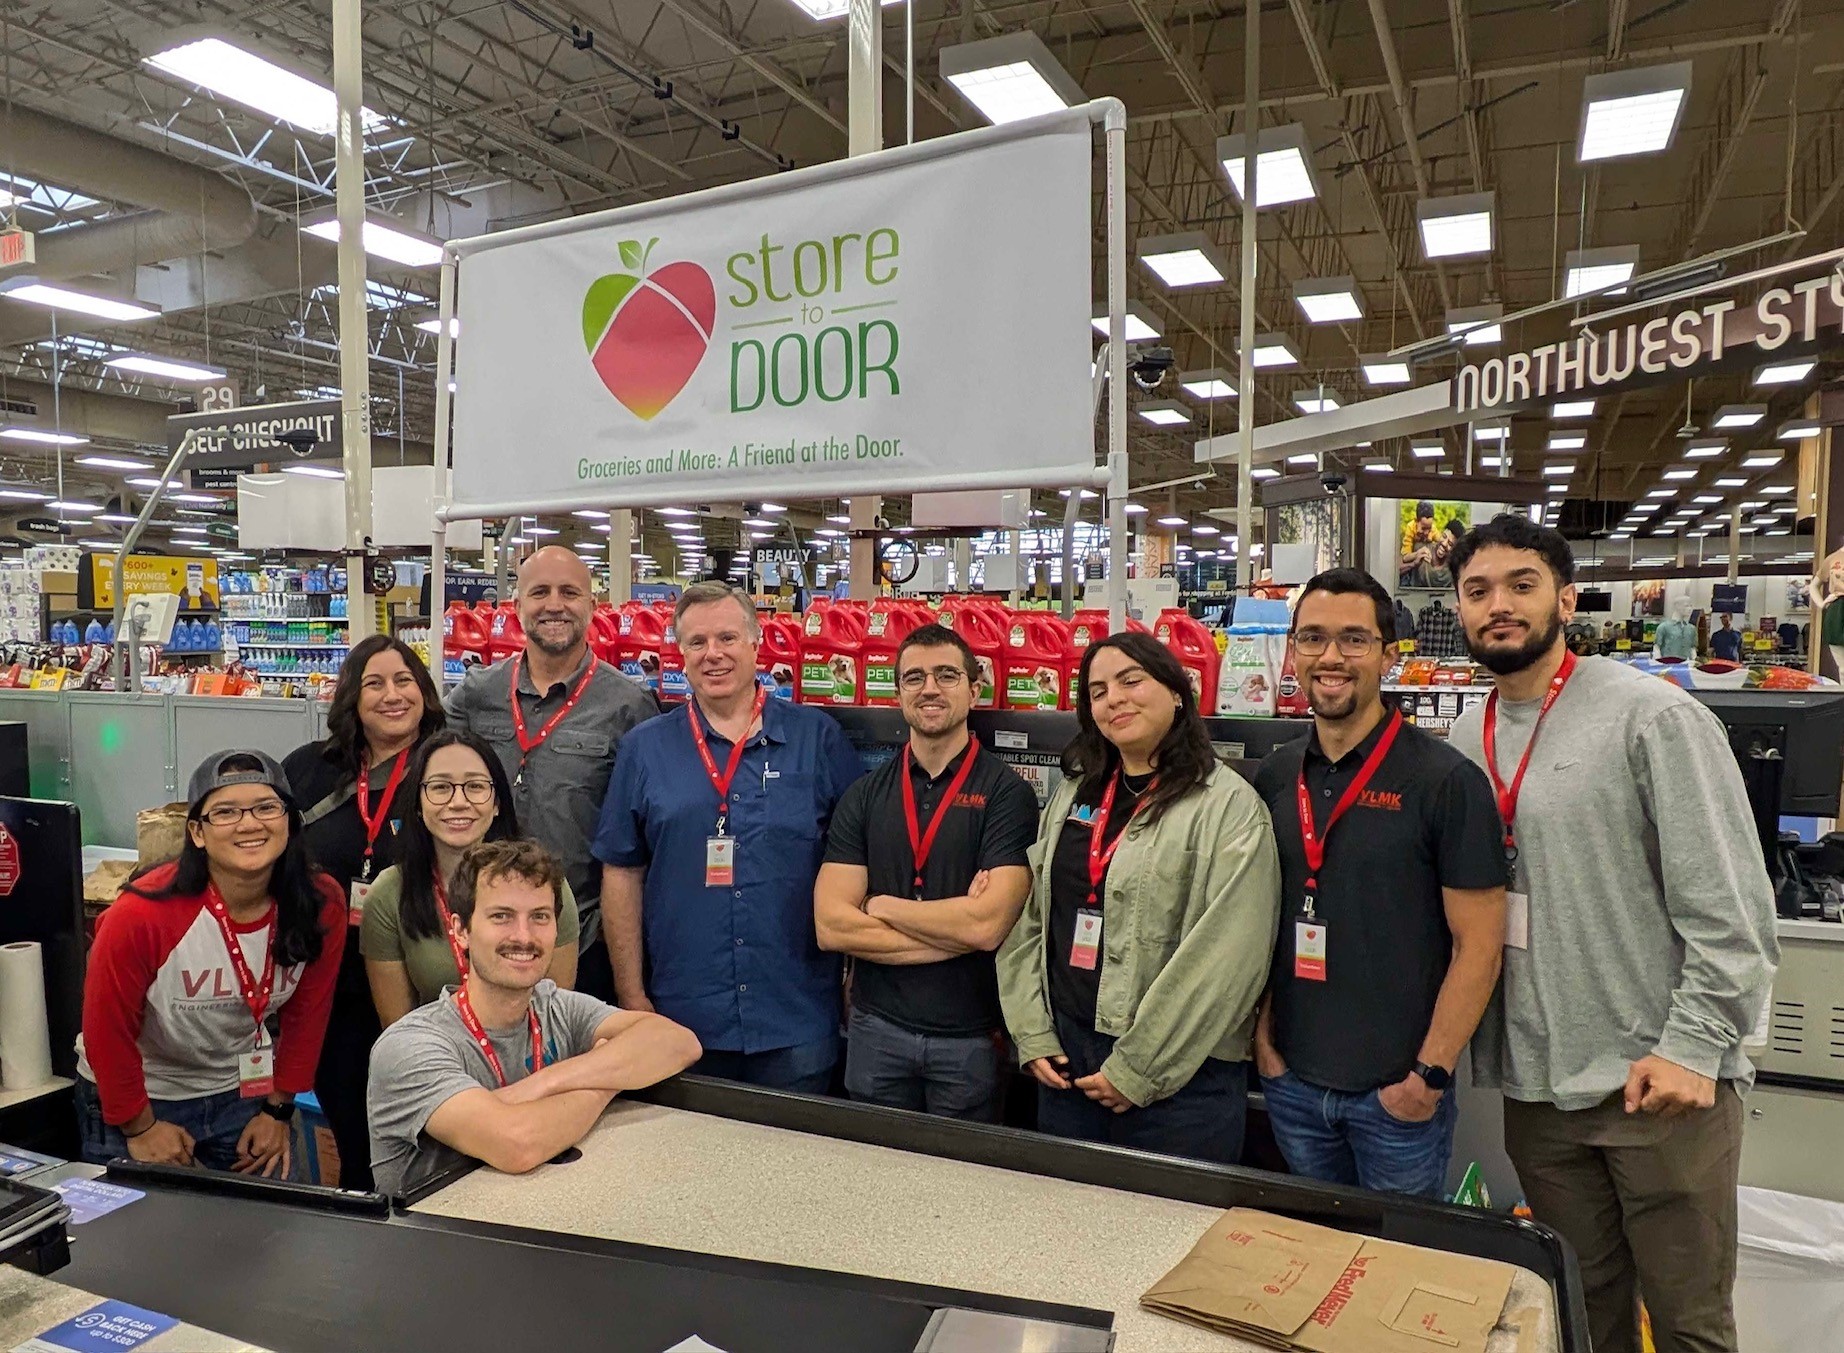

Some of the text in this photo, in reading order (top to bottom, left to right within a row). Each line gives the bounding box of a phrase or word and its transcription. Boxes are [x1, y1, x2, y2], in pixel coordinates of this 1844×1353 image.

[726, 228, 900, 308] store
[800, 303, 824, 325] to
[1456, 300, 1736, 413] NORTHWEST
[730, 319, 900, 413] DOOR
[202, 386, 234, 412] 29
[577, 434, 904, 479] Groceries and More: A Friend at the Door.
[756, 549, 811, 563] BEAUTY
[123, 571, 168, 581] SAVINGS
[104, 581, 143, 590] ERY
[803, 666, 828, 678] PET
[867, 668, 895, 680] PET
[1008, 678, 1033, 689] PET
[996, 752, 1019, 763] RTABLE
[1020, 754, 1038, 764] SPOT
[1361, 790, 1402, 807] VLMK
[181, 966, 299, 998] VLK
[171, 1002, 244, 1011] ENGINEERI
